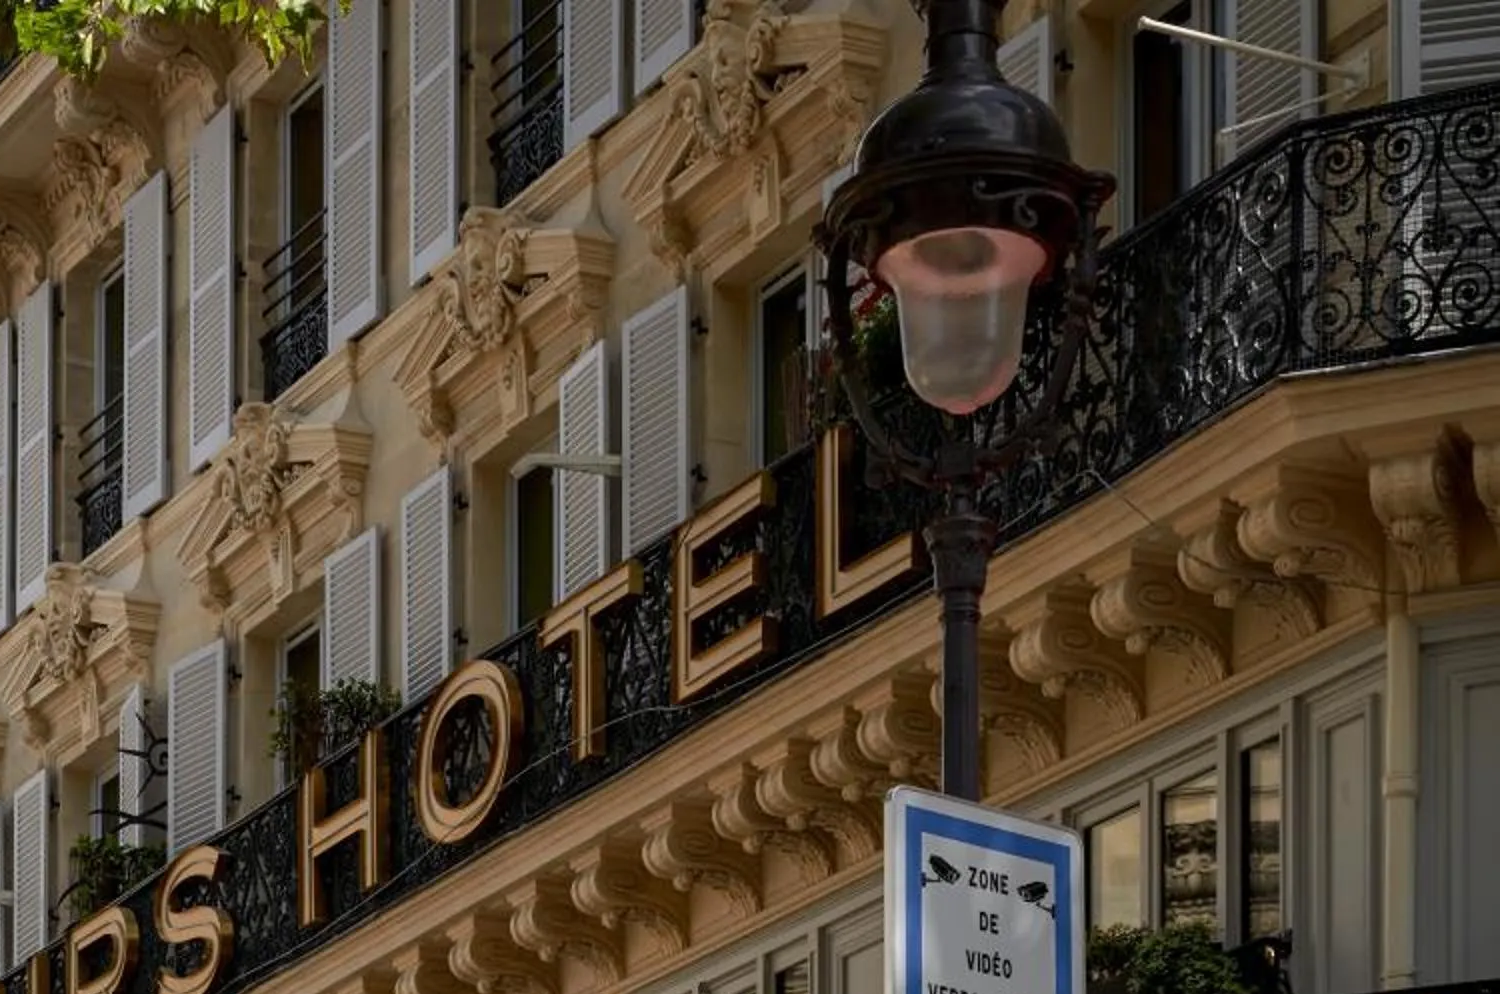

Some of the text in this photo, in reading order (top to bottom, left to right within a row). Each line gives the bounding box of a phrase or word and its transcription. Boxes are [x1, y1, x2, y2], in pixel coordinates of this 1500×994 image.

[298, 421, 930, 930] HOTEL
[967, 866, 1009, 896] ZONE
[979, 911, 999, 934] DE
[965, 949, 1013, 979] VIDÉO
